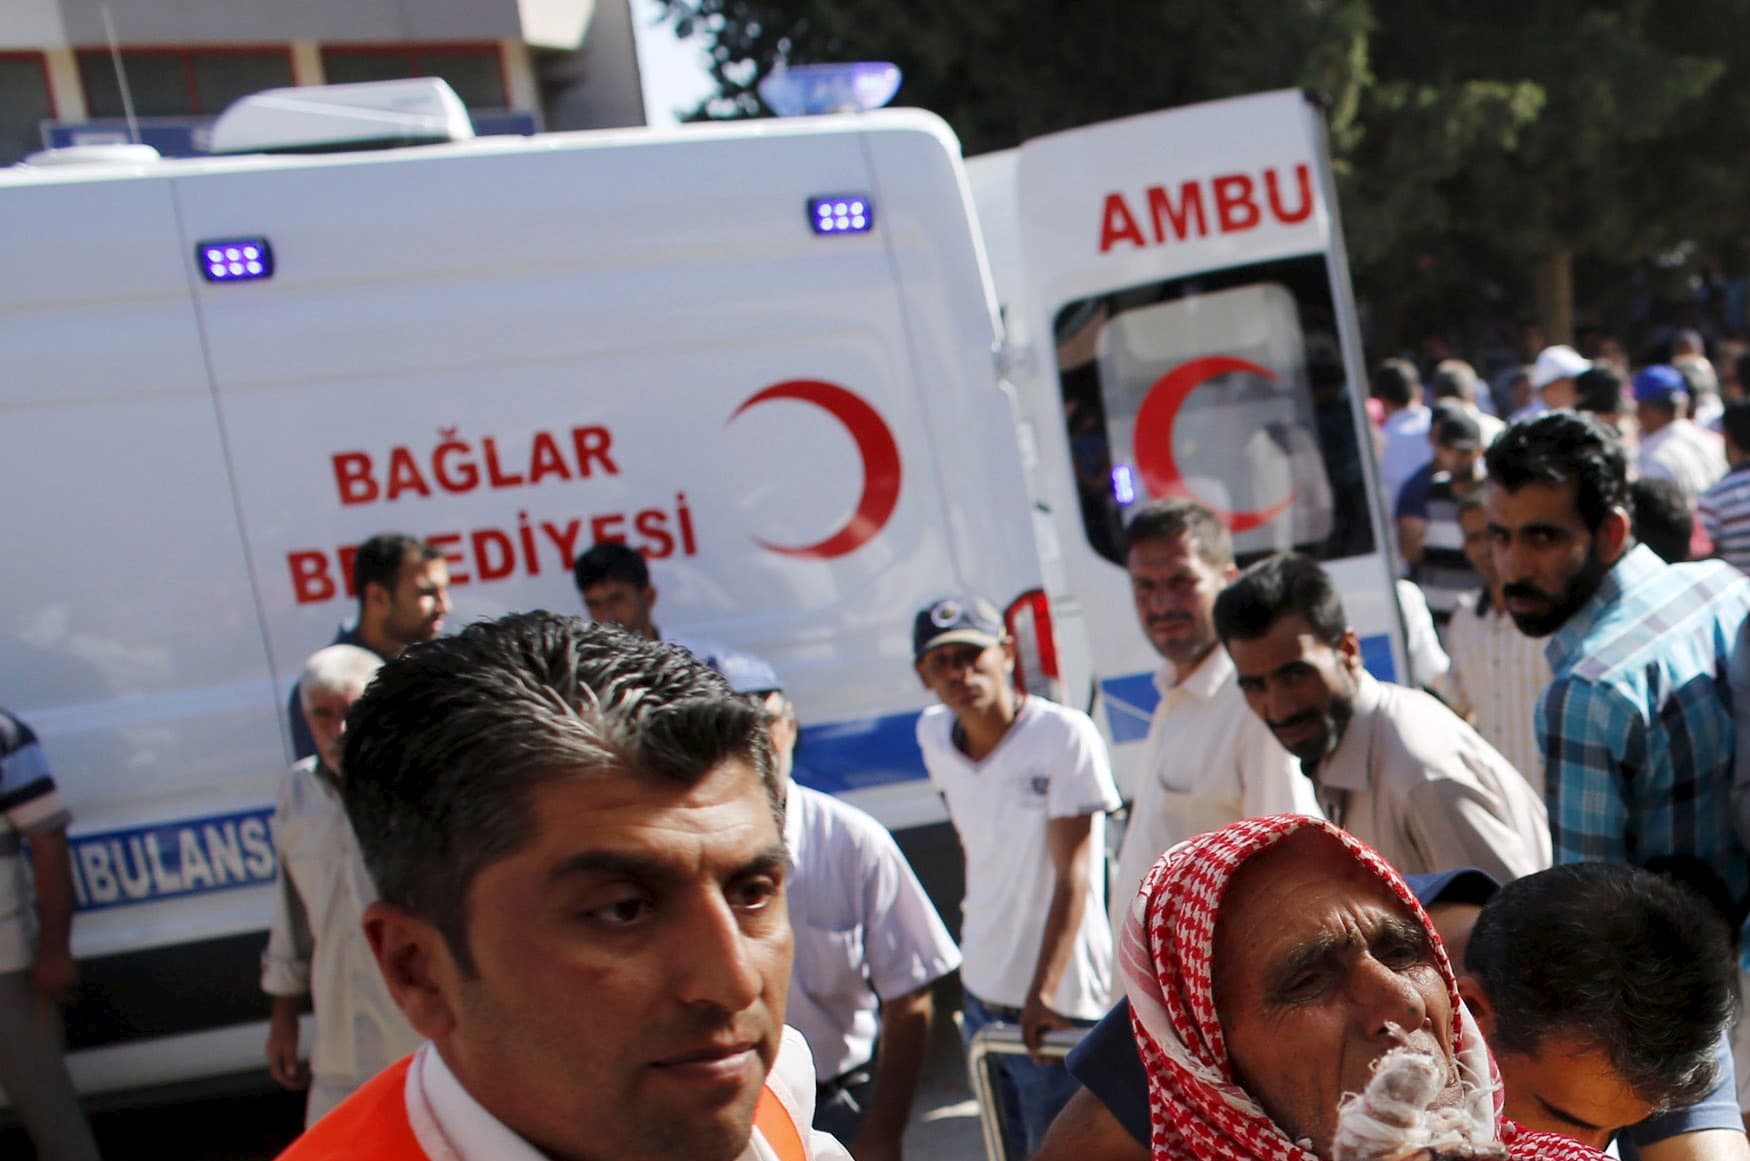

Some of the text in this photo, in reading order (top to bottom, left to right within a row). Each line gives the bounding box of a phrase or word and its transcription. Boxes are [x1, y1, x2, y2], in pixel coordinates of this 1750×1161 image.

[1098, 164, 1314, 253] AMBU
[331, 425, 619, 506] BAĞLAR
[287, 491, 698, 605] BEDİYESİ
